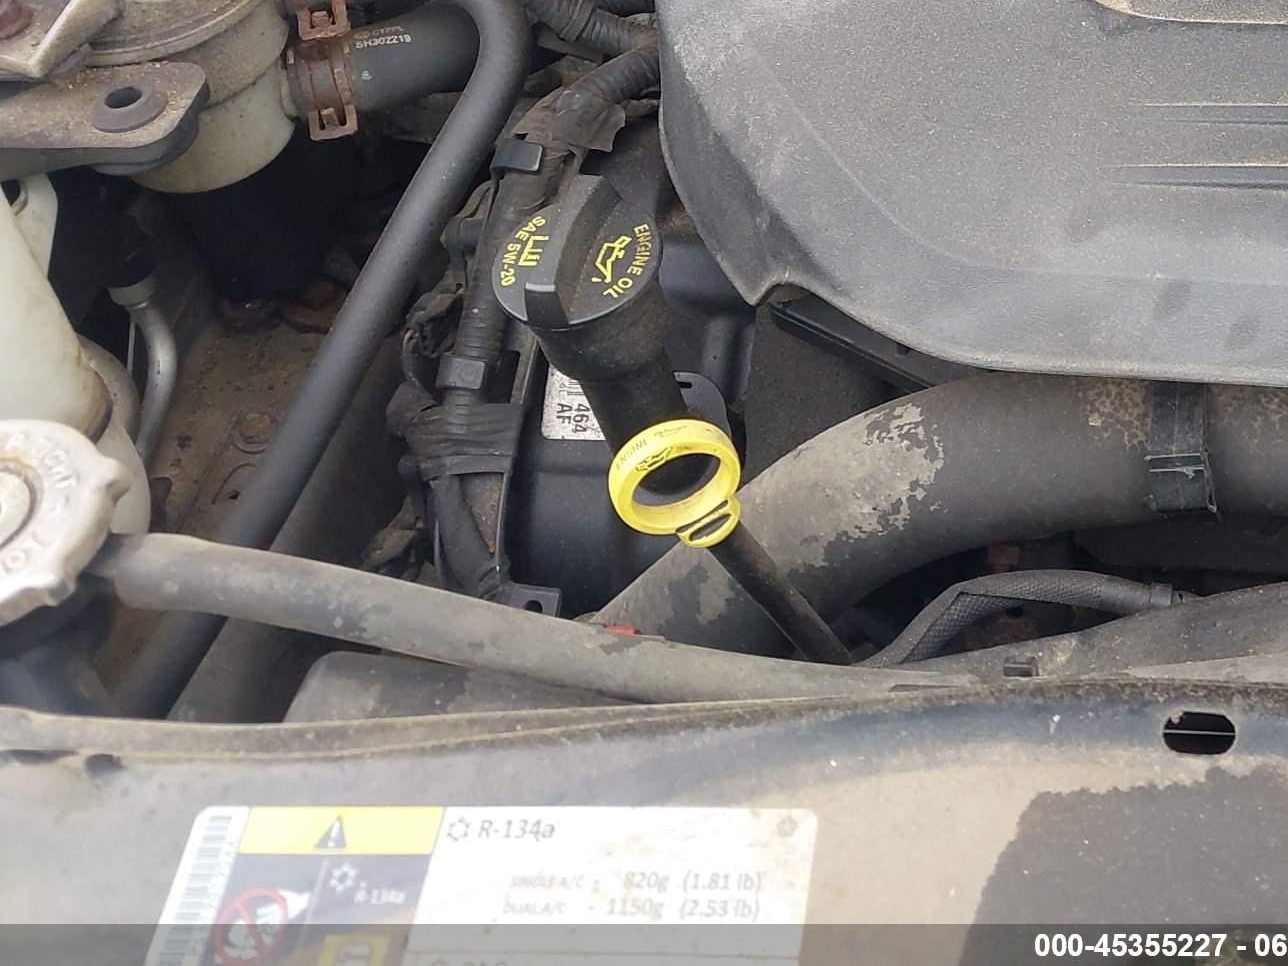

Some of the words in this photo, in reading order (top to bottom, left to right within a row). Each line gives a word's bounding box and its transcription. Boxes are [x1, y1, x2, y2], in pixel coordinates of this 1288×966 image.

[514, 216, 546, 242] SAE
[626, 223, 652, 276] ENGINE
[500, 243, 522, 286] 5W-20
[602, 277, 633, 298] OIL
[556, 402, 573, 425] AF
[571, 403, 591, 434] 464
[477, 818, 556, 843] R-134a
[623, 871, 671, 893] 820g
[682, 870, 730, 893] (1.81
[737, 870, 763, 893] lb)
[606, 897, 665, 921] 1150g
[678, 897, 730, 922] (2.53
[733, 898, 762, 922] lb)
